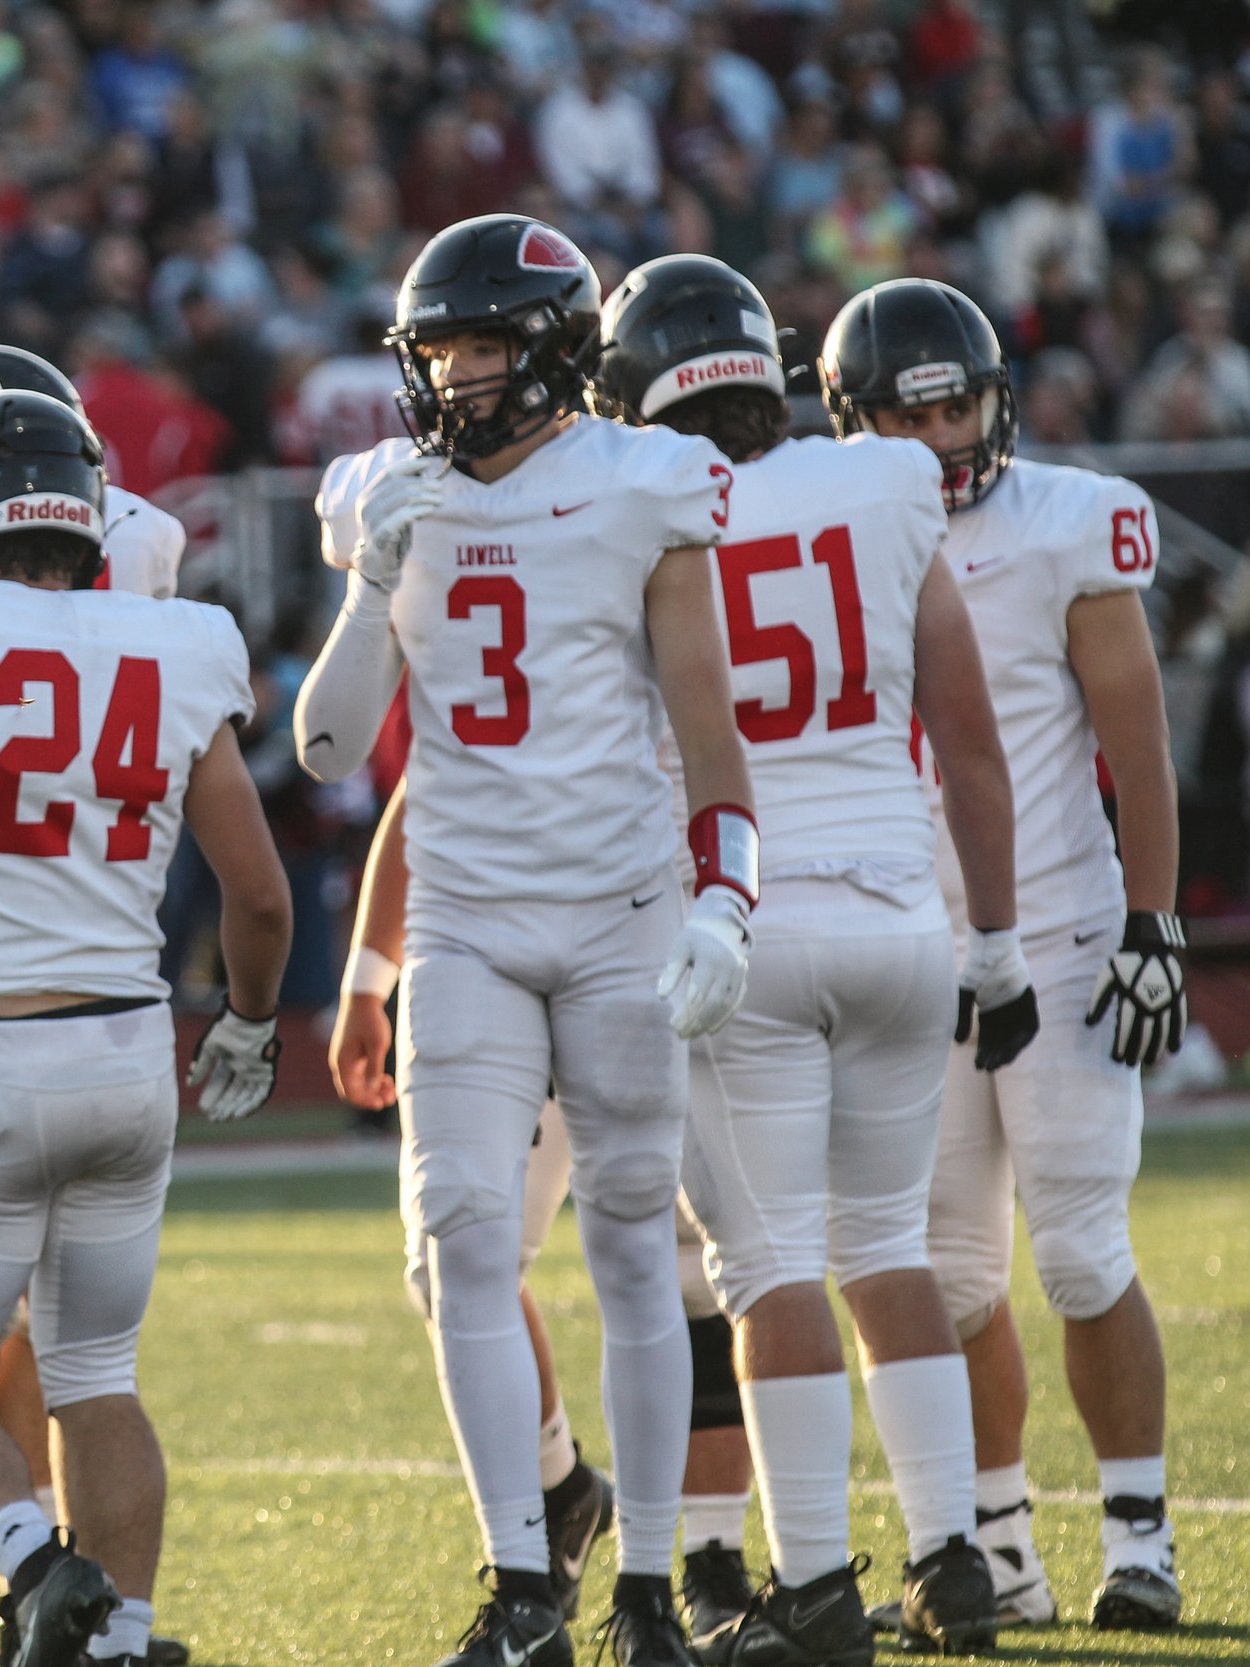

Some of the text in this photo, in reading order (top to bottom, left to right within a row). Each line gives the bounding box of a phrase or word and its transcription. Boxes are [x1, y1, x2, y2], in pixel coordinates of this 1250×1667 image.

[676, 357, 766, 389] Riddell
[7, 501, 91, 526] Riddell
[709, 463, 734, 528] 3
[456, 544, 517, 566] LOWELL
[1111, 506, 1153, 573] 61
[447, 575, 530, 747] 3
[716, 523, 877, 744] 51
